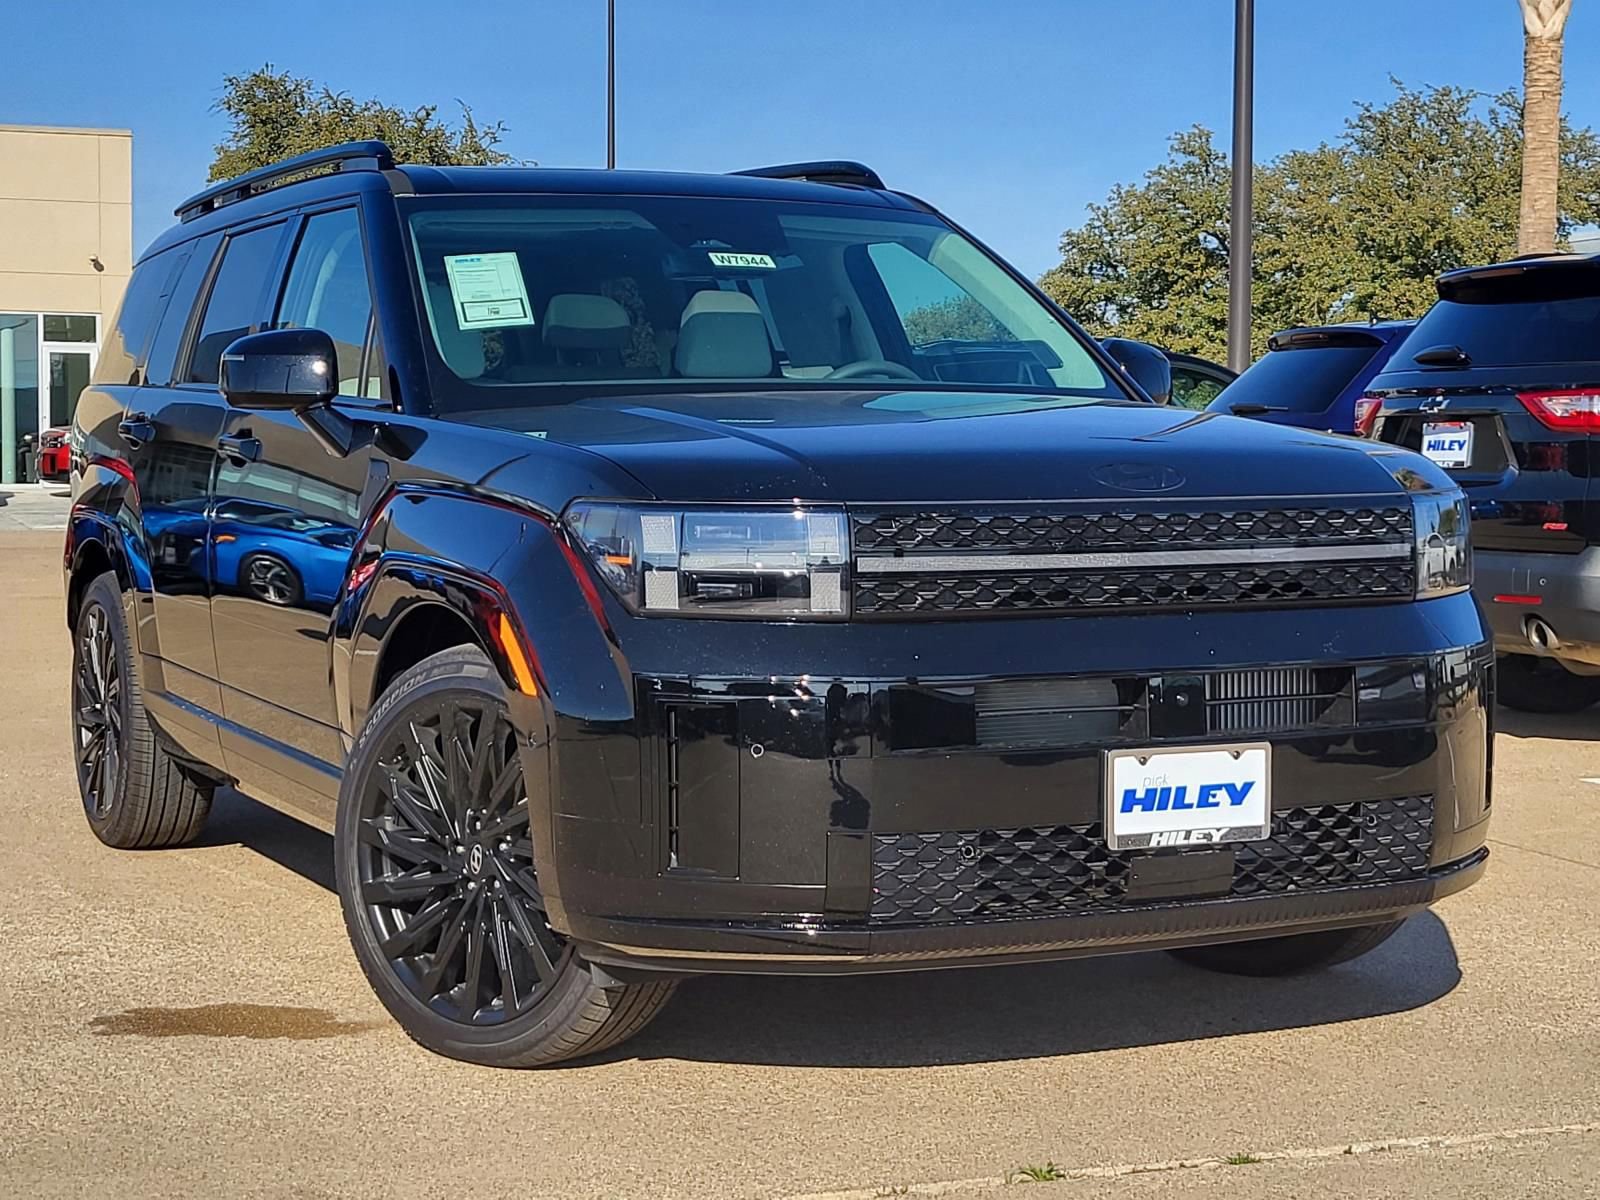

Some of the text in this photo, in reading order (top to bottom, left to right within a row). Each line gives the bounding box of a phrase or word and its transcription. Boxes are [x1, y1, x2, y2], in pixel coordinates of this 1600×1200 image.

[714, 254, 768, 266] W7944
[1427, 440, 1466, 451] HILEY
[1120, 781, 1256, 813] HILEY
[1149, 828, 1230, 847] HILEY
